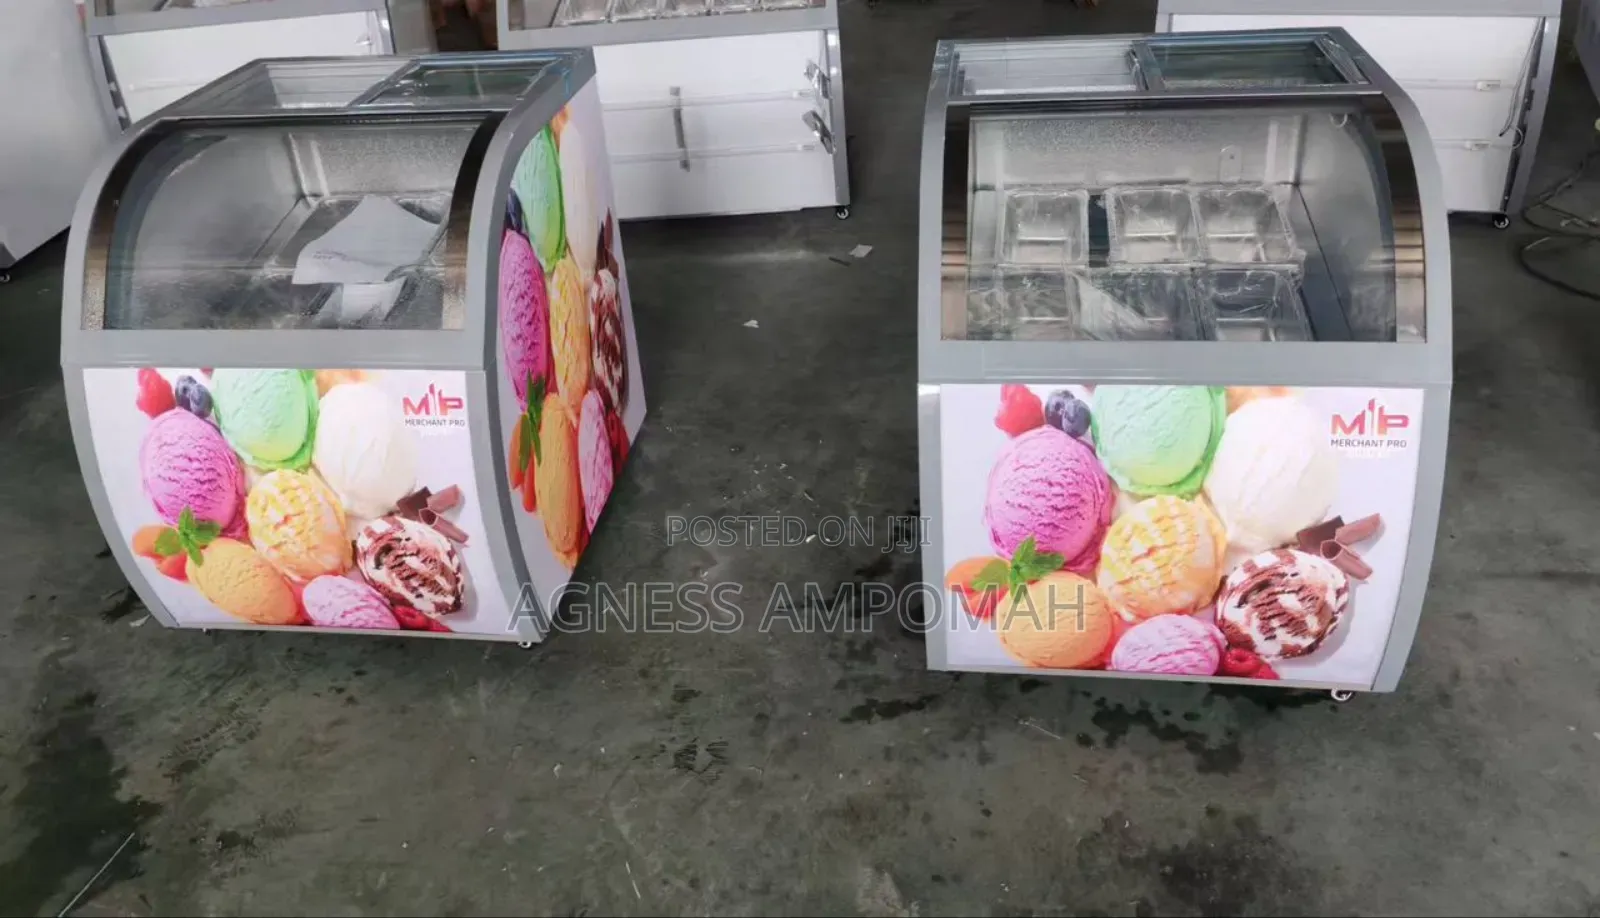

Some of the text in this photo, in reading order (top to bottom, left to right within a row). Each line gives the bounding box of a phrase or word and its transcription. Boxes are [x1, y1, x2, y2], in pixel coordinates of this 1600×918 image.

[405, 418, 466, 428] MERCHANT PRO
[1330, 438, 1407, 449] MERCHANT PRO
